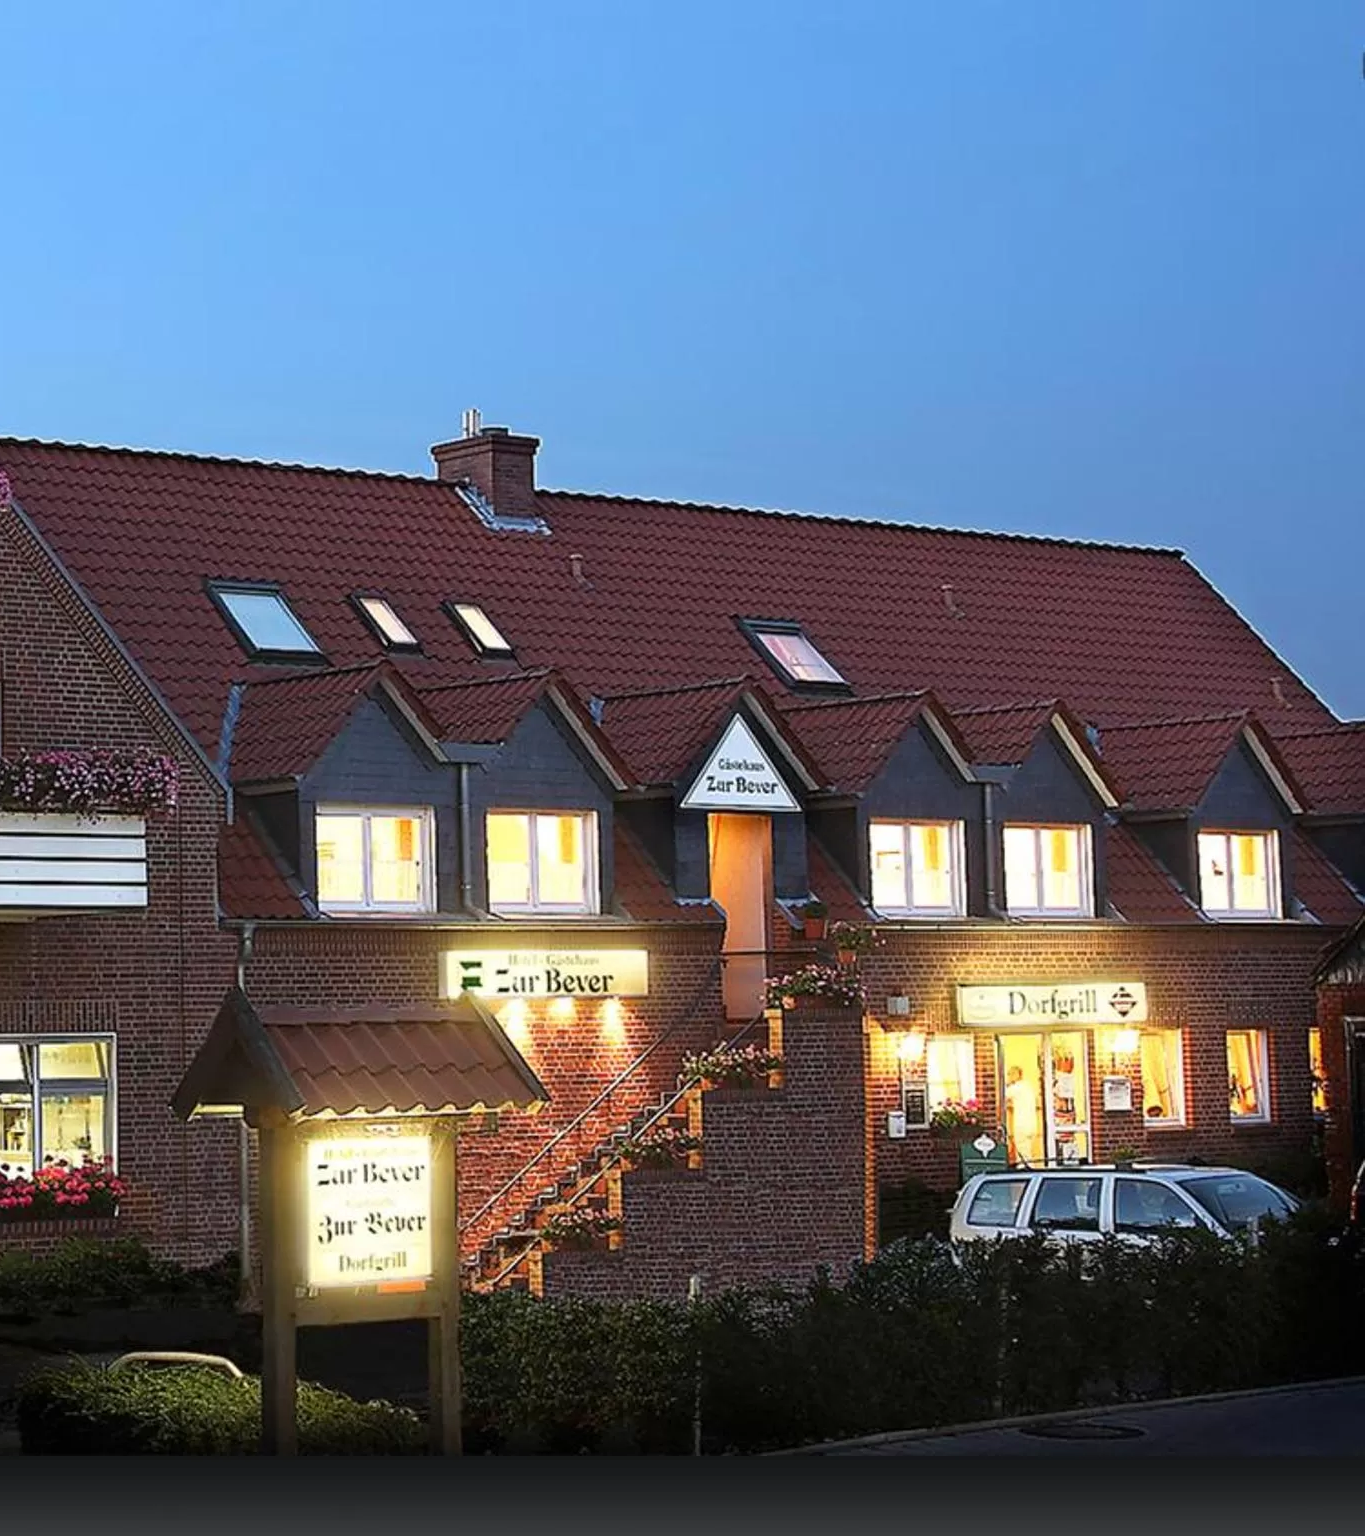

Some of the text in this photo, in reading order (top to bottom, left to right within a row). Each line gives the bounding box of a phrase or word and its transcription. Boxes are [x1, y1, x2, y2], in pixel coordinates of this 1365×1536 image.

[718, 758, 765, 772] Gästehaus
[706, 776, 779, 794] Zur Bever
[495, 967, 614, 993] Zur Bever
[1008, 989, 1098, 1020] Dorfgrill
[317, 1162, 425, 1186] Zur Bever
[317, 1211, 427, 1245] Zur Bever
[339, 1250, 408, 1273] Dorfgrill
